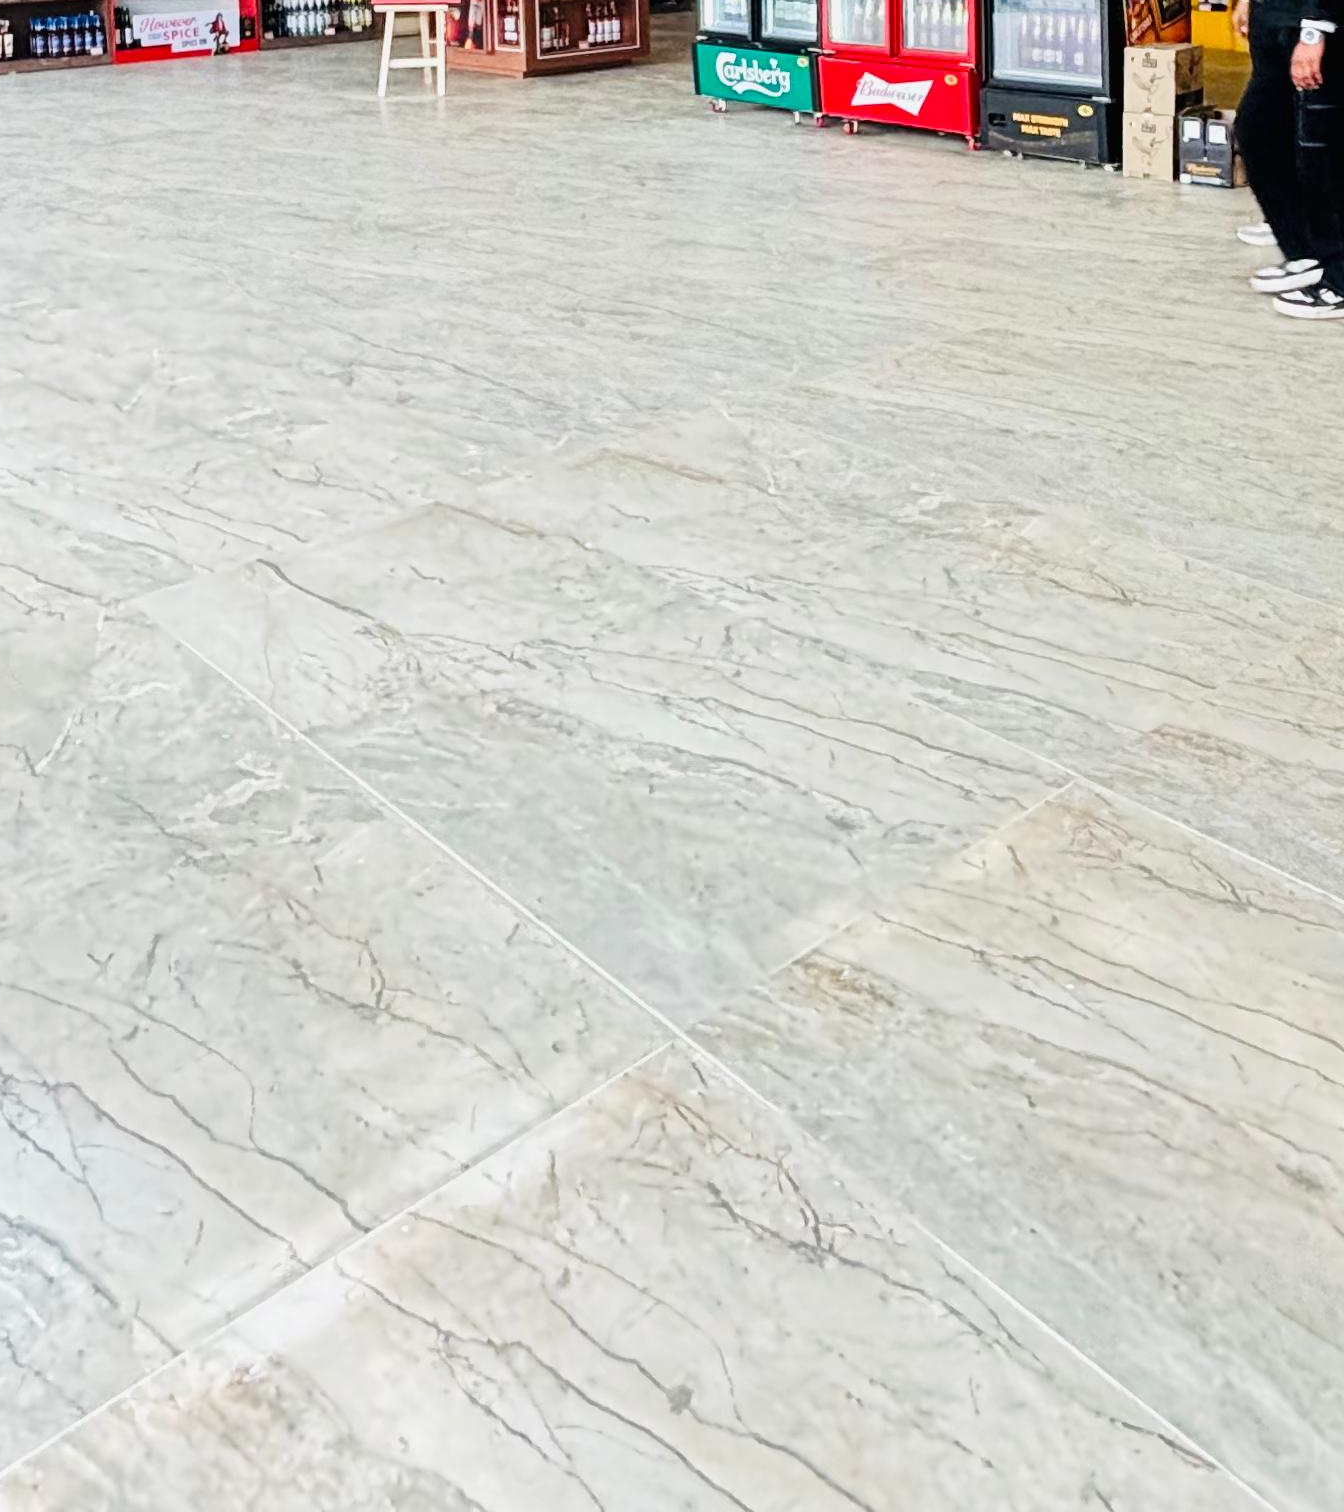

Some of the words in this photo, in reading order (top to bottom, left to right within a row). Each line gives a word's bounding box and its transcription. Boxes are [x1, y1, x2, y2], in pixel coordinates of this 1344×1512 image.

[163, 28, 200, 40] SPICE
[716, 52, 790, 96] Carlsberg
[856, 79, 923, 101] Budweiser
